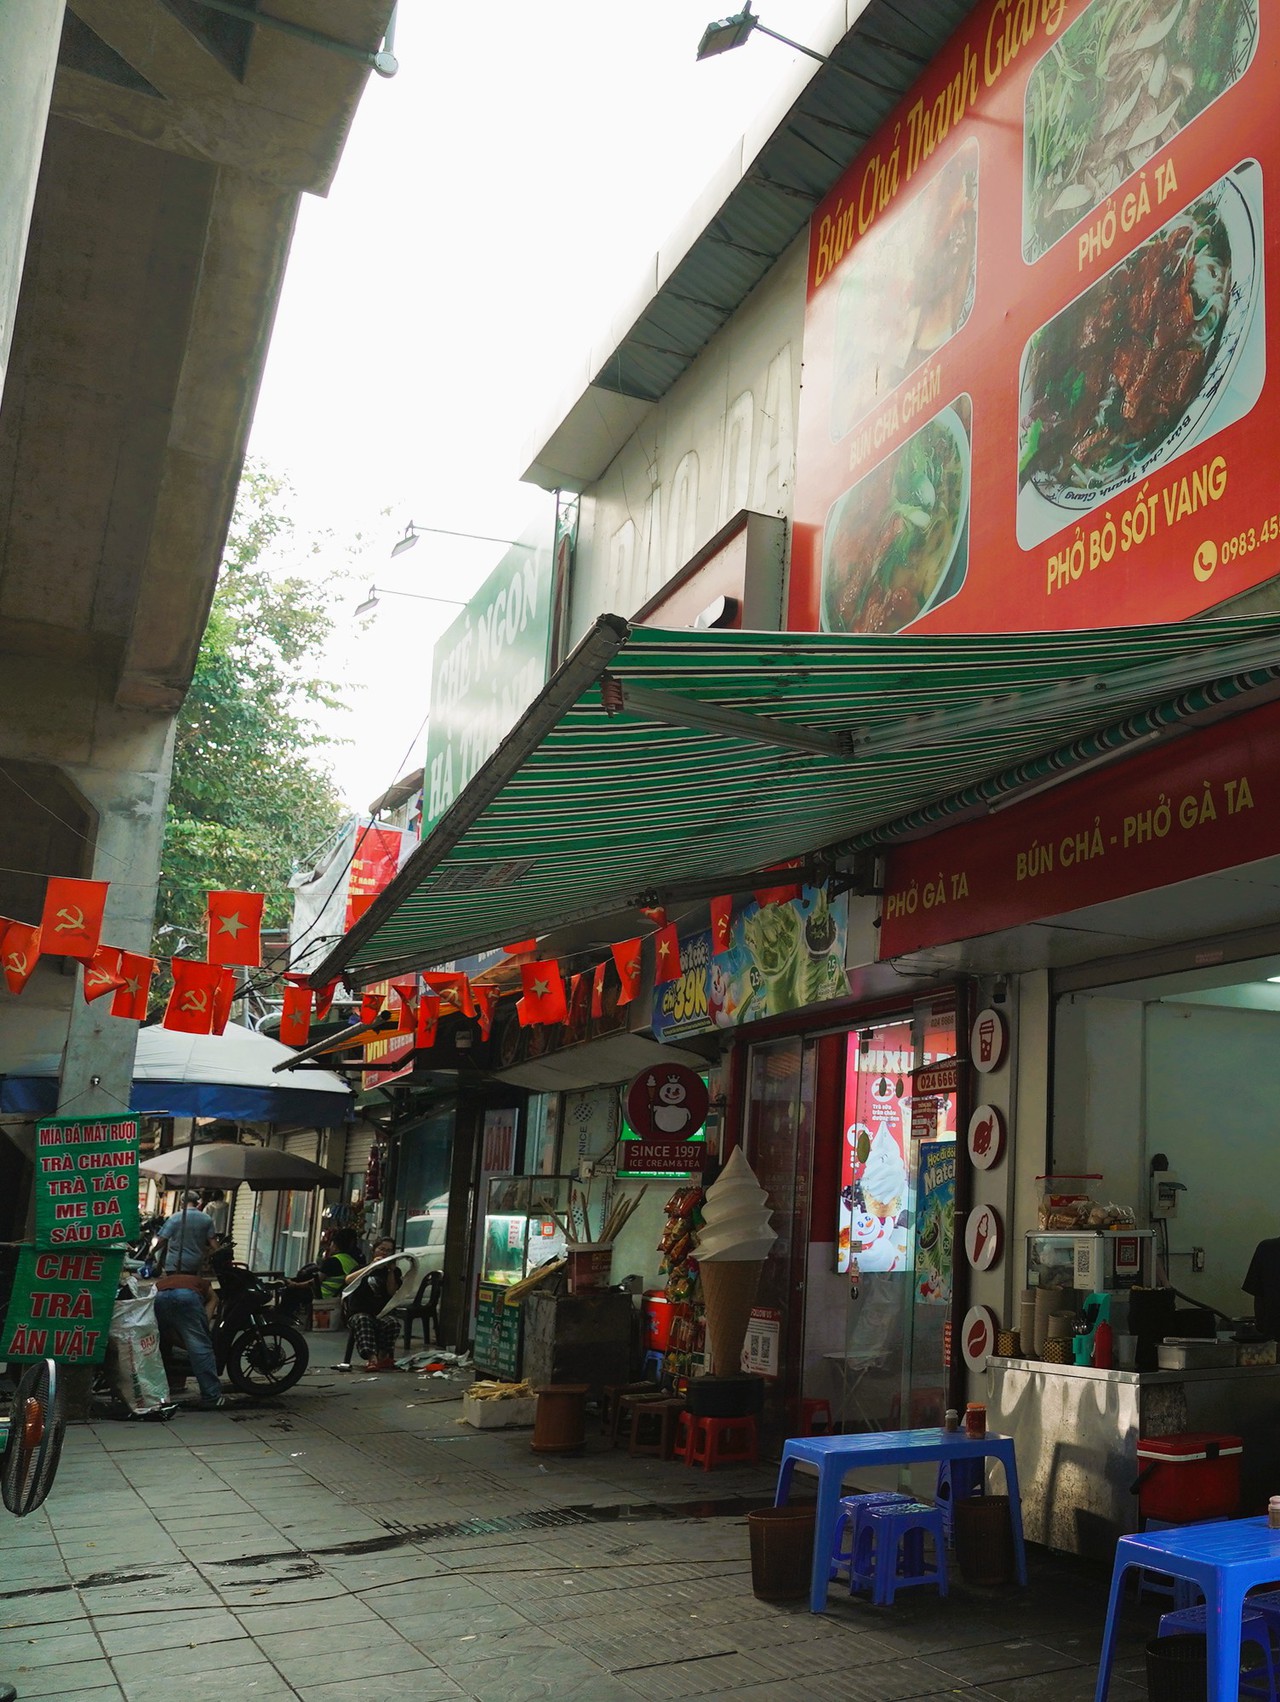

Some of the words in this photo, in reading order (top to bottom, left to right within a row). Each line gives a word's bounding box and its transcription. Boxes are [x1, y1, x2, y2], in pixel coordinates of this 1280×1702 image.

[814, 199, 855, 287] Bún
[858, 122, 901, 234] Chả
[906, 43, 979, 182] Thanh
[1077, 196, 1117, 272] PHỞ
[1120, 170, 1151, 233] GÀ
[1152, 159, 1178, 203] TA
[902, 360, 941, 423] CHẤM
[1065, 491, 1096, 502] Giang
[1100, 471, 1137, 496] Thanh
[1047, 527, 1085, 595] PHỞ
[1090, 512, 1116, 571] BÒ
[1121, 480, 1159, 552] SỐT
[1162, 456, 1228, 526] VANG
[1016, 840, 1053, 881] BÚN
[1060, 815, 1105, 867] CHẢ
[1123, 793, 1172, 848] PHỞ
[1179, 780, 1217, 830] GÀ
[1224, 776, 1255, 815] TA
[886, 879, 919, 920] PHỞ
[922, 872, 946, 909] GÀ
[951, 872, 970, 901] TA
[921, 1074, 936, 1089] 024
[40, 1124, 62, 1146] MÍA
[64, 1123, 80, 1144] ĐÁ
[83, 1121, 108, 1143] MÁT
[110, 1120, 137, 1144] RƯỢI
[41, 1153, 74, 1172] TRÀ
[78, 1150, 136, 1169] CHANH
[630, 1159, 642, 1167] ICE
[631, 1145, 670, 1157] SINCE
[675, 1146, 701, 1158] 1997
[48, 1176, 87, 1196] TRÀ
[92, 1171, 130, 1192] TẮC
[56, 1202, 88, 1219] ME
[93, 1195, 121, 1216] ĐÁ
[50, 1221, 93, 1243] SẤU
[97, 1219, 126, 1240] ĐÁ
[35, 1252, 104, 1282] CHÈ
[30, 1288, 94, 1319] TRÀ
[8, 1323, 49, 1357] ĂN
[53, 1324, 101, 1362] VẶT
